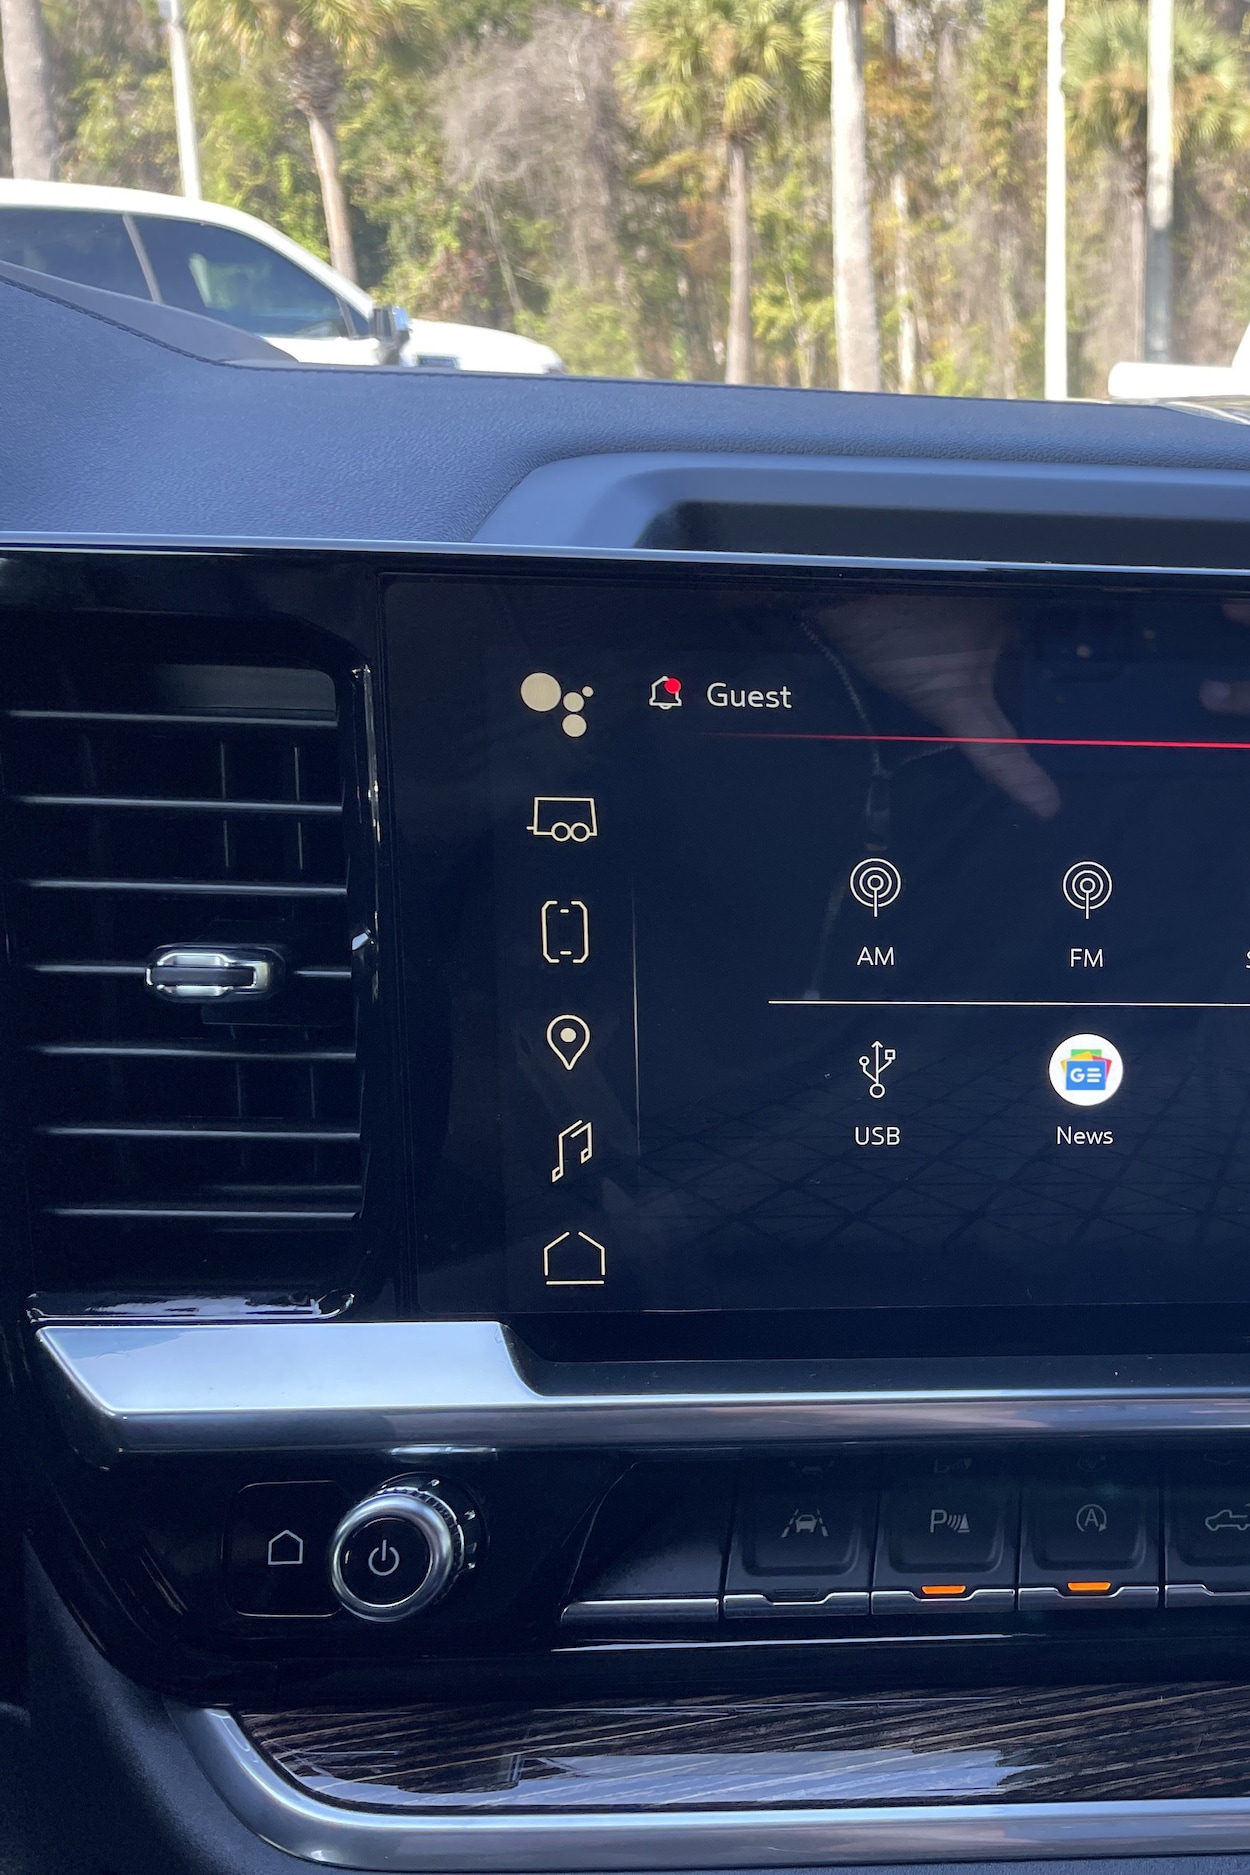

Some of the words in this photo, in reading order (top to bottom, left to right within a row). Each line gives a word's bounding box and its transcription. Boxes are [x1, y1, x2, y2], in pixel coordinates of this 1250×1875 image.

[706, 682, 793, 709] Guest
[856, 947, 896, 966] AM
[1070, 948, 1104, 968] FM
[854, 1127, 901, 1146] USB
[1056, 1126, 1114, 1145] News
